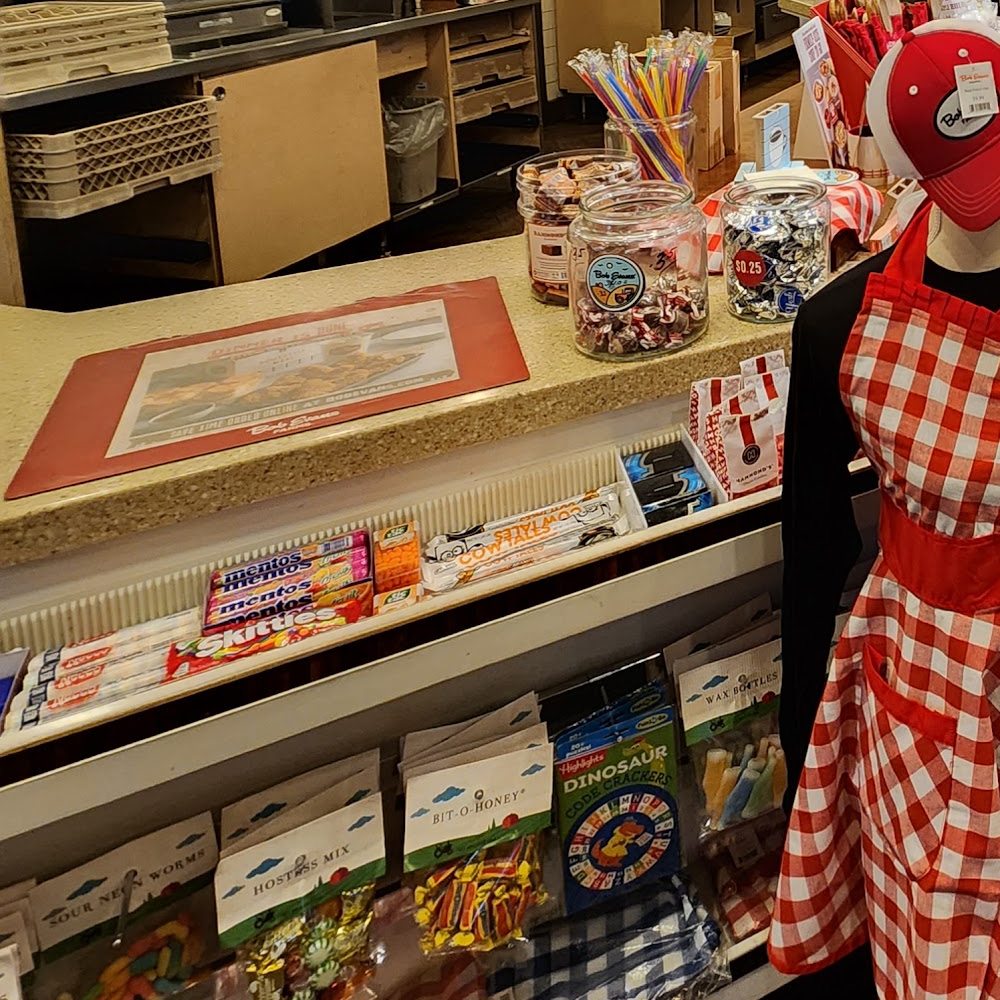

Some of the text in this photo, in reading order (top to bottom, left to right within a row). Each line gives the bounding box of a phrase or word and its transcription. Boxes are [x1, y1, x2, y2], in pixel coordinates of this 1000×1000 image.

[593, 270, 610, 279] Bob
[735, 260, 763, 275] $0.25
[170, 426, 196, 439] SAVE
[199, 419, 224, 431] TIME
[227, 412, 261, 426] ORDER
[263, 405, 298, 418] ONLINE
[302, 400, 321, 409] AT
[246, 410, 341, 436] Bob Evans
[672, 469, 689, 499] 5
[458, 526, 552, 567] COW TALES
[222, 561, 312, 594] mentos
[223, 552, 302, 584] mentos
[219, 579, 312, 615] mentos
[195, 607, 337, 658] Skittles
[705, 690, 729, 705] WAX
[559, 753, 605, 775] Highlights
[563, 745, 668, 793] DINOSAUR
[565, 771, 672, 819] CODE CRACKERS
[323, 843, 351, 866] MIX
[49, 902, 94, 930] SOUR
[149, 848, 206, 882] WORMS
